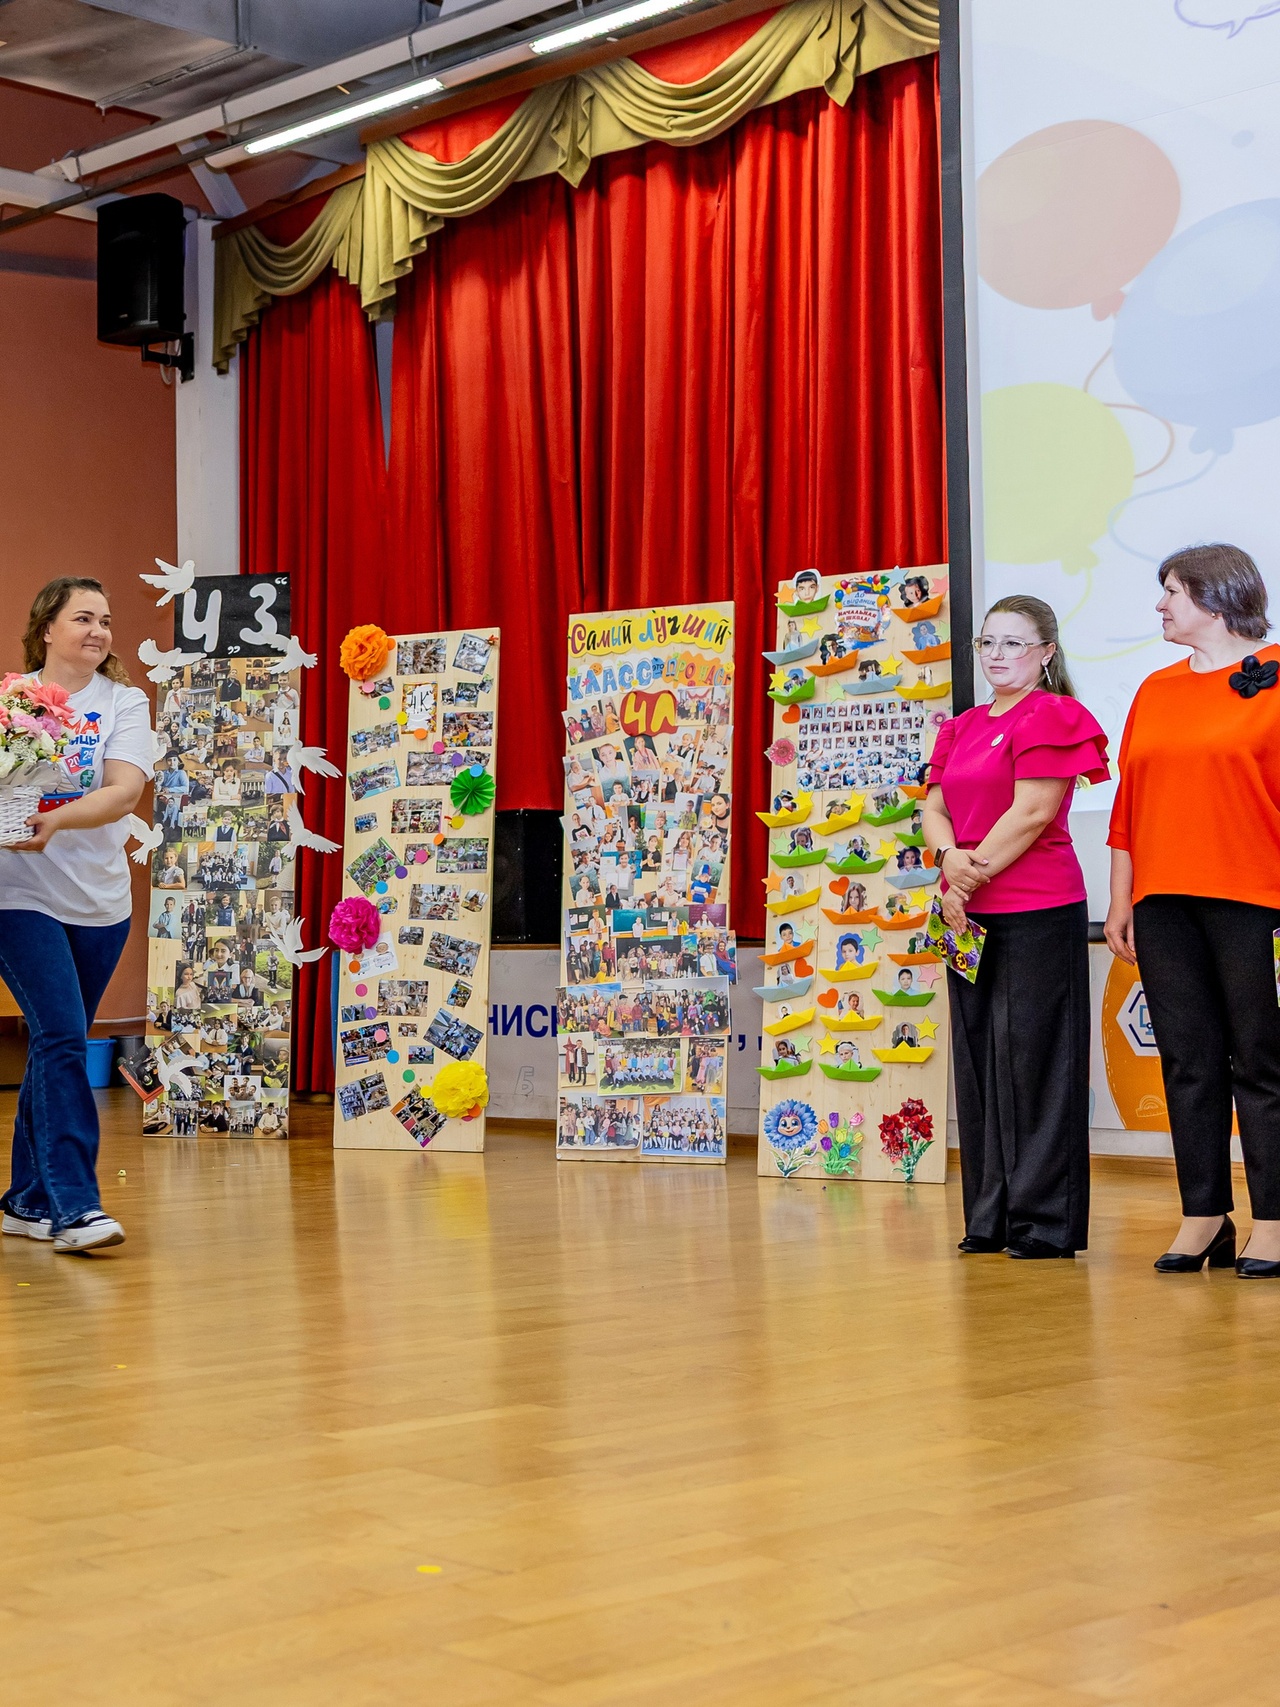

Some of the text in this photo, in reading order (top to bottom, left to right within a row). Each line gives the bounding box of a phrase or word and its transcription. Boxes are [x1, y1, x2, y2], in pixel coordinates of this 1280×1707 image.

[571, 619, 632, 654] Самый
[569, 660, 652, 701] КЛАСС
[665, 658, 697, 682] ПРО
[67, 749, 94, 768] 20 25
